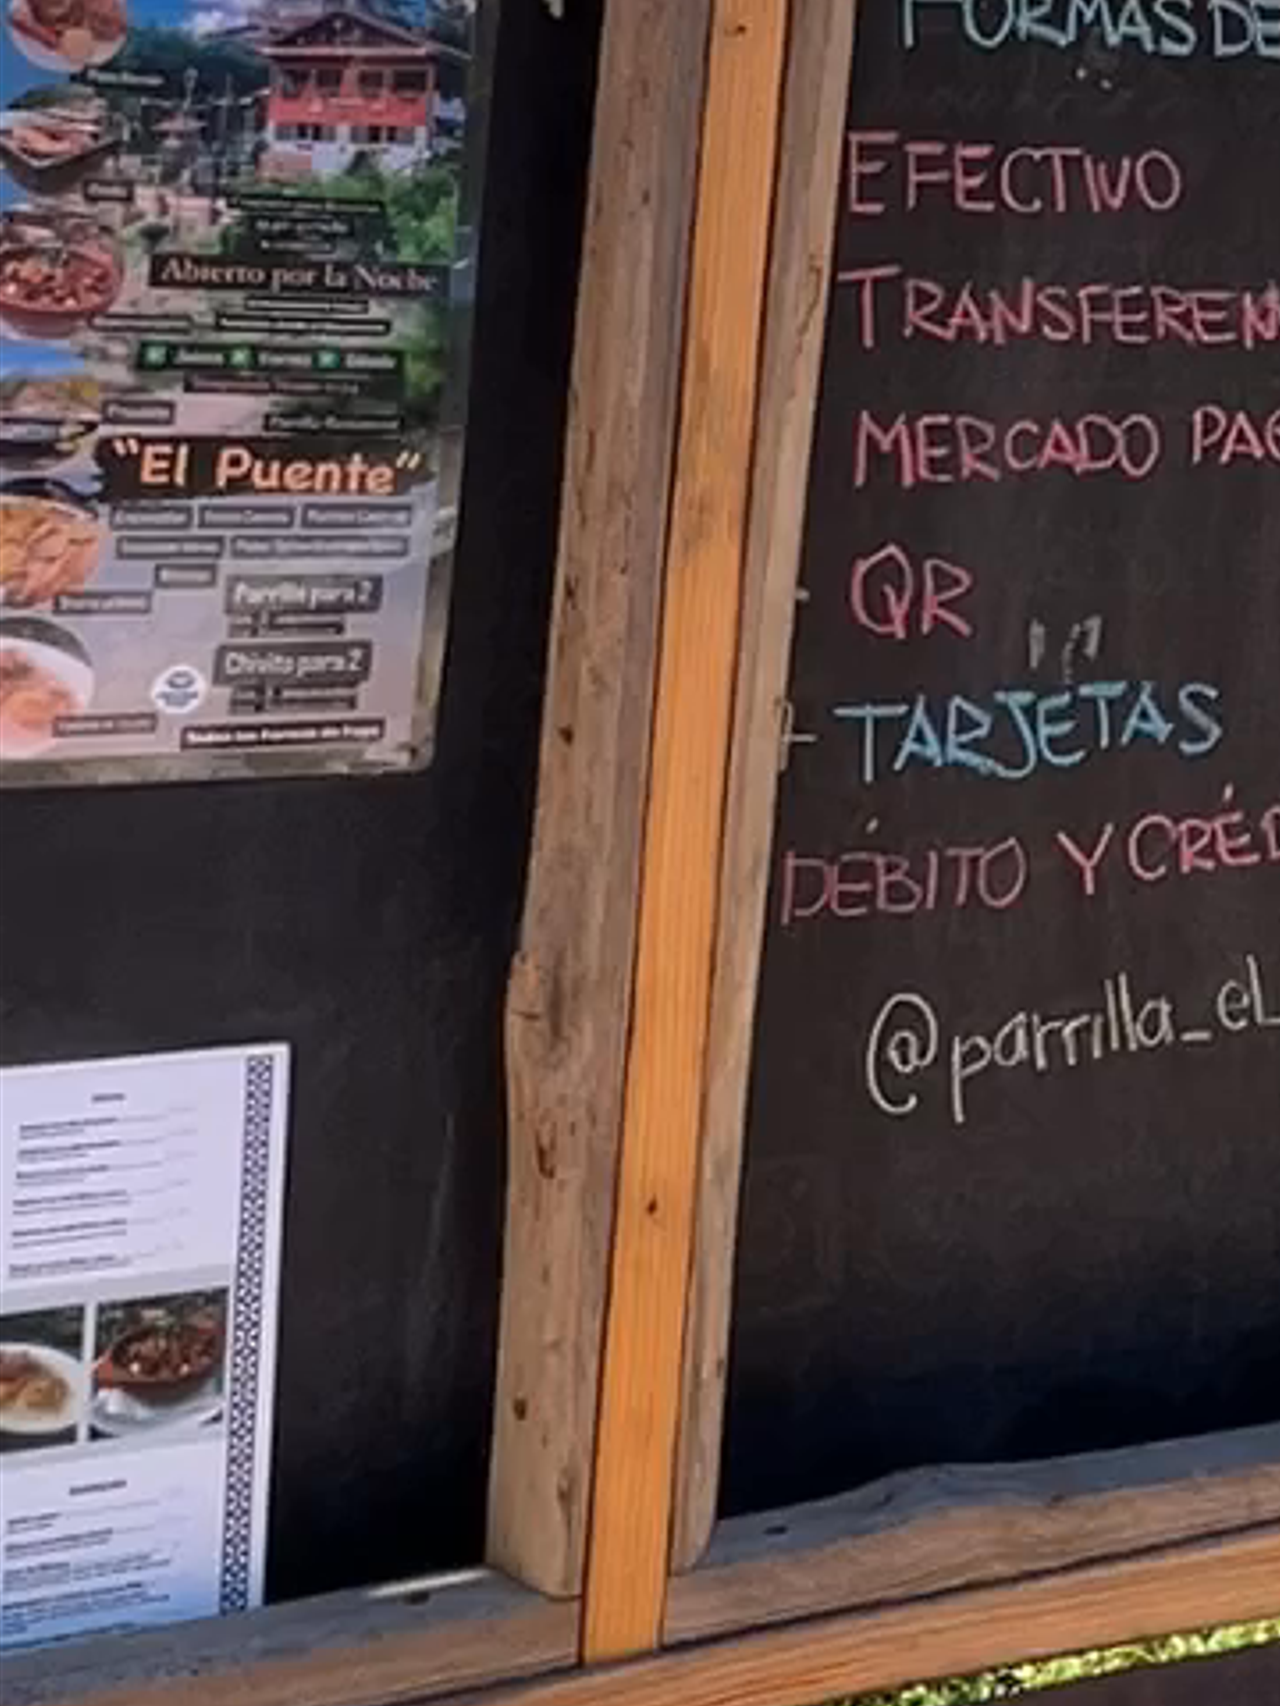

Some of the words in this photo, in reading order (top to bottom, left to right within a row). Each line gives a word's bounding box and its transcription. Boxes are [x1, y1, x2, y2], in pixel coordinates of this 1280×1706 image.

[846, 132, 1182, 215] EFECTIVO
[161, 257, 265, 284] Abierto
[271, 267, 318, 293] por
[324, 264, 347, 287] la
[354, 265, 438, 293] Noche
[853, 409, 1160, 488] MERCADO
[851, 543, 973, 640] QR
[296, 655, 346, 677] para
[348, 650, 363, 671] 2
[834, 679, 1225, 783] TARJETAS
[1058, 823, 1114, 896] Y
